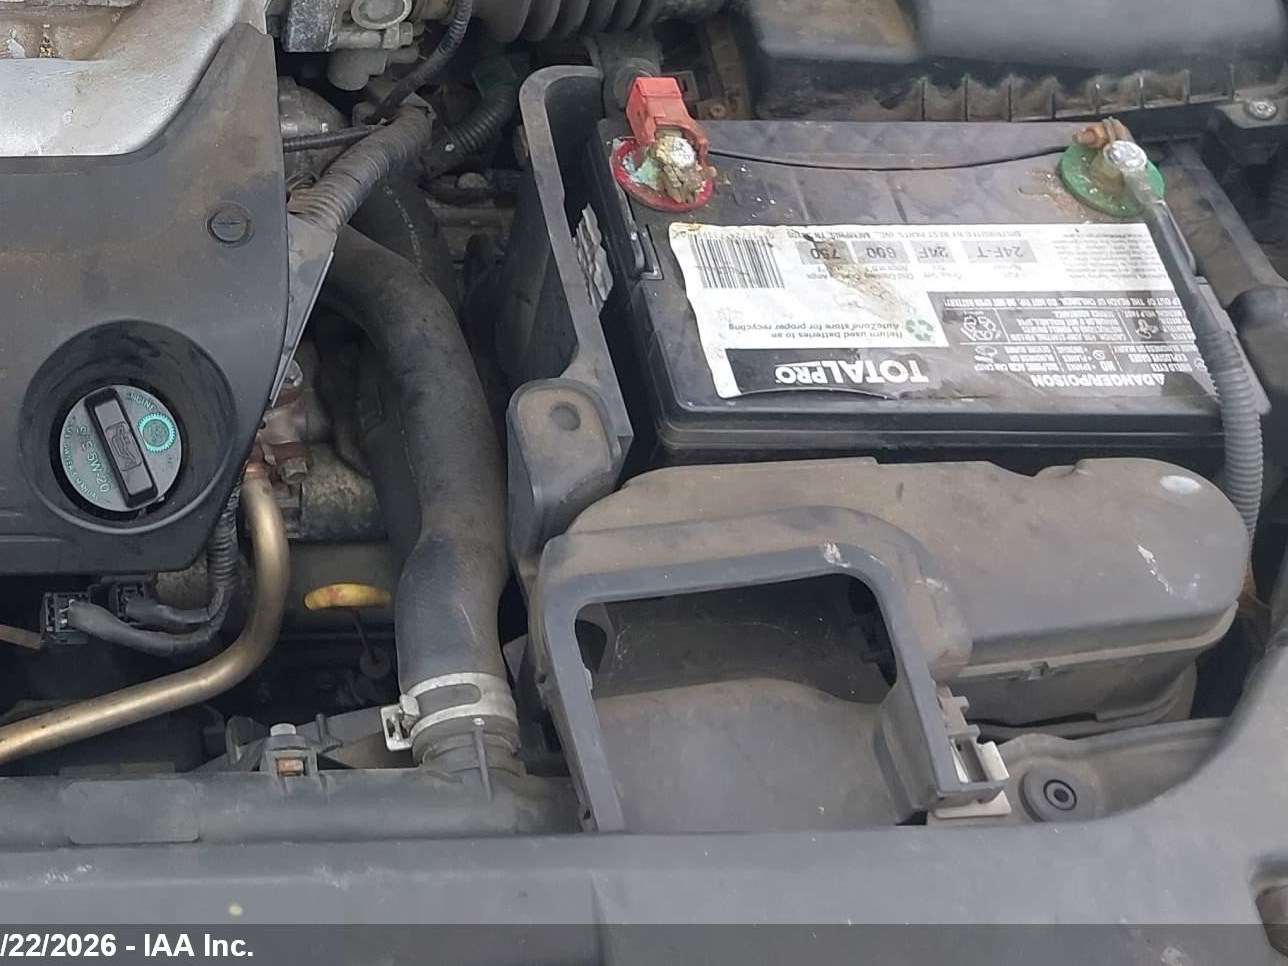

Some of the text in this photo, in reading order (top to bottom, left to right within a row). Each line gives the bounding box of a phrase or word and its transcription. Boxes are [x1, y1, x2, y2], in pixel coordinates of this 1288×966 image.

[866, 247, 896, 259] 600
[918, 246, 947, 259] 24F
[976, 246, 1024, 258] 24F-T
[728, 322, 772, 331] recycling
[774, 322, 806, 330] proper
[808, 323, 823, 331] for
[775, 360, 929, 384] TOTALPRO
[1100, 361, 1116, 372] NO
[87, 451, 110, 493] 5W-20
